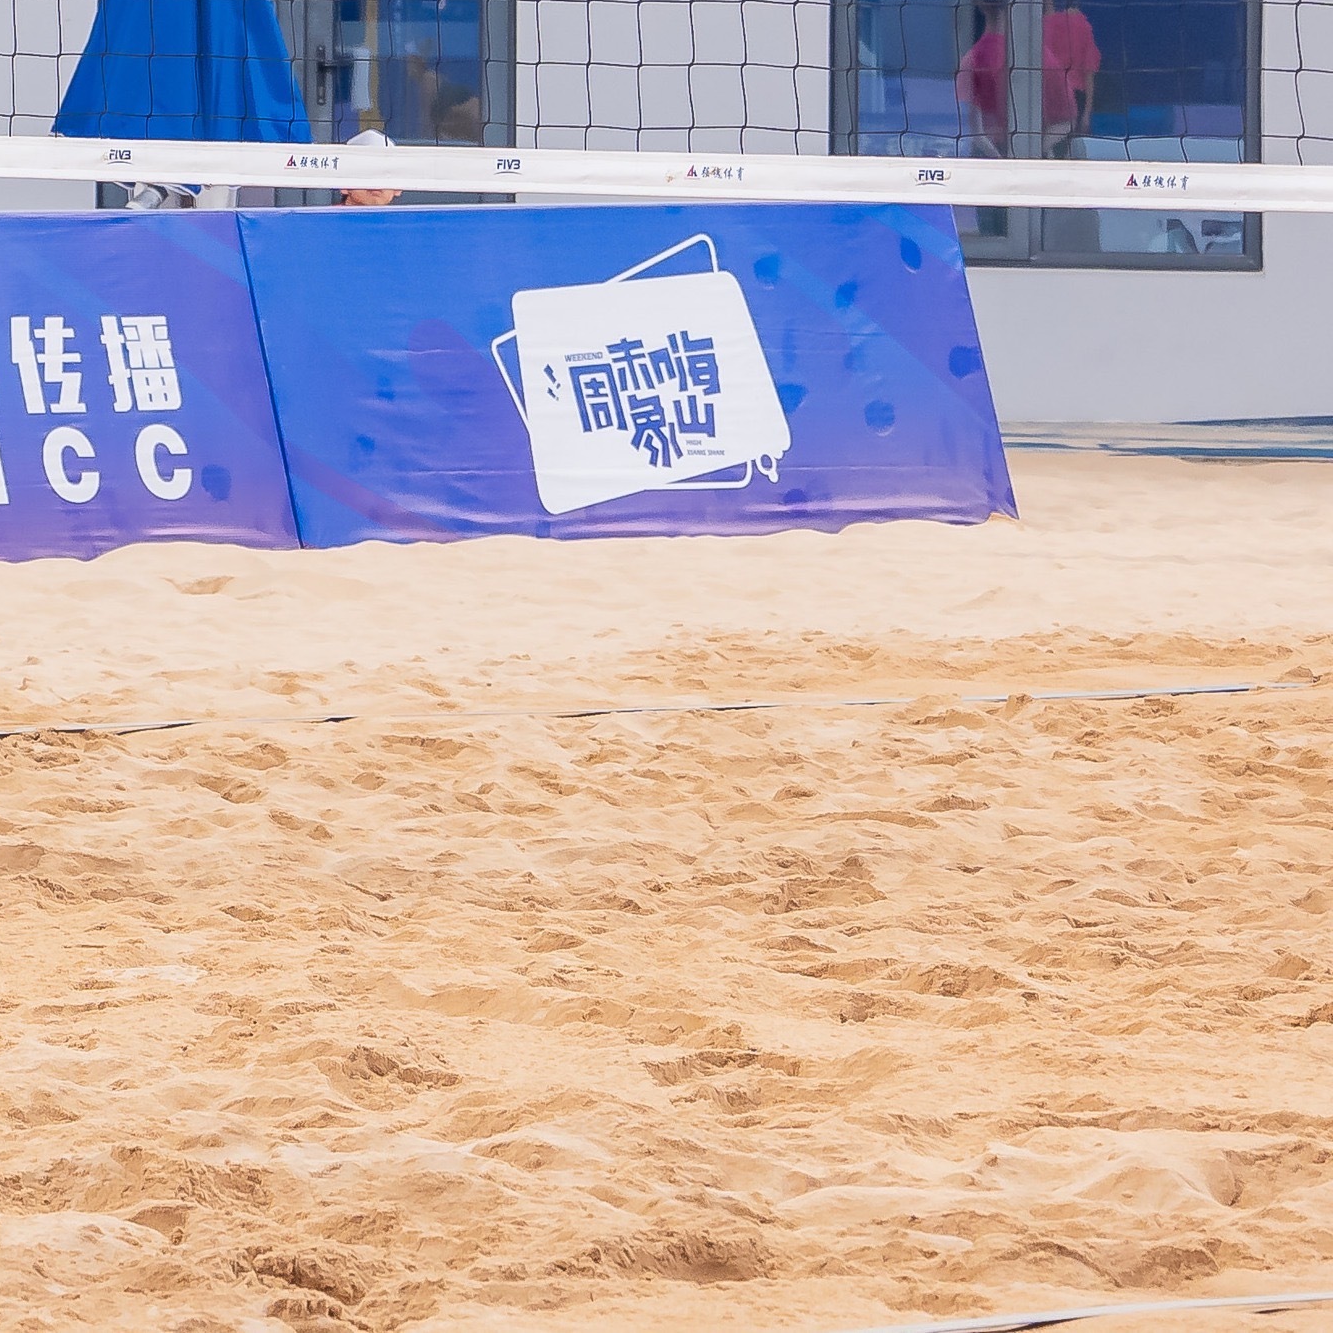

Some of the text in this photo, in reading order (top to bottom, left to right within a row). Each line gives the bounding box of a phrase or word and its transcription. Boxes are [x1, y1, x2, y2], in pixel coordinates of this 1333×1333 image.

[109, 149, 131, 160] FIVB
[497, 159, 521, 169] FIVB
[918, 170, 944, 181] FIVB
[564, 352, 604, 362] WEEKEND
